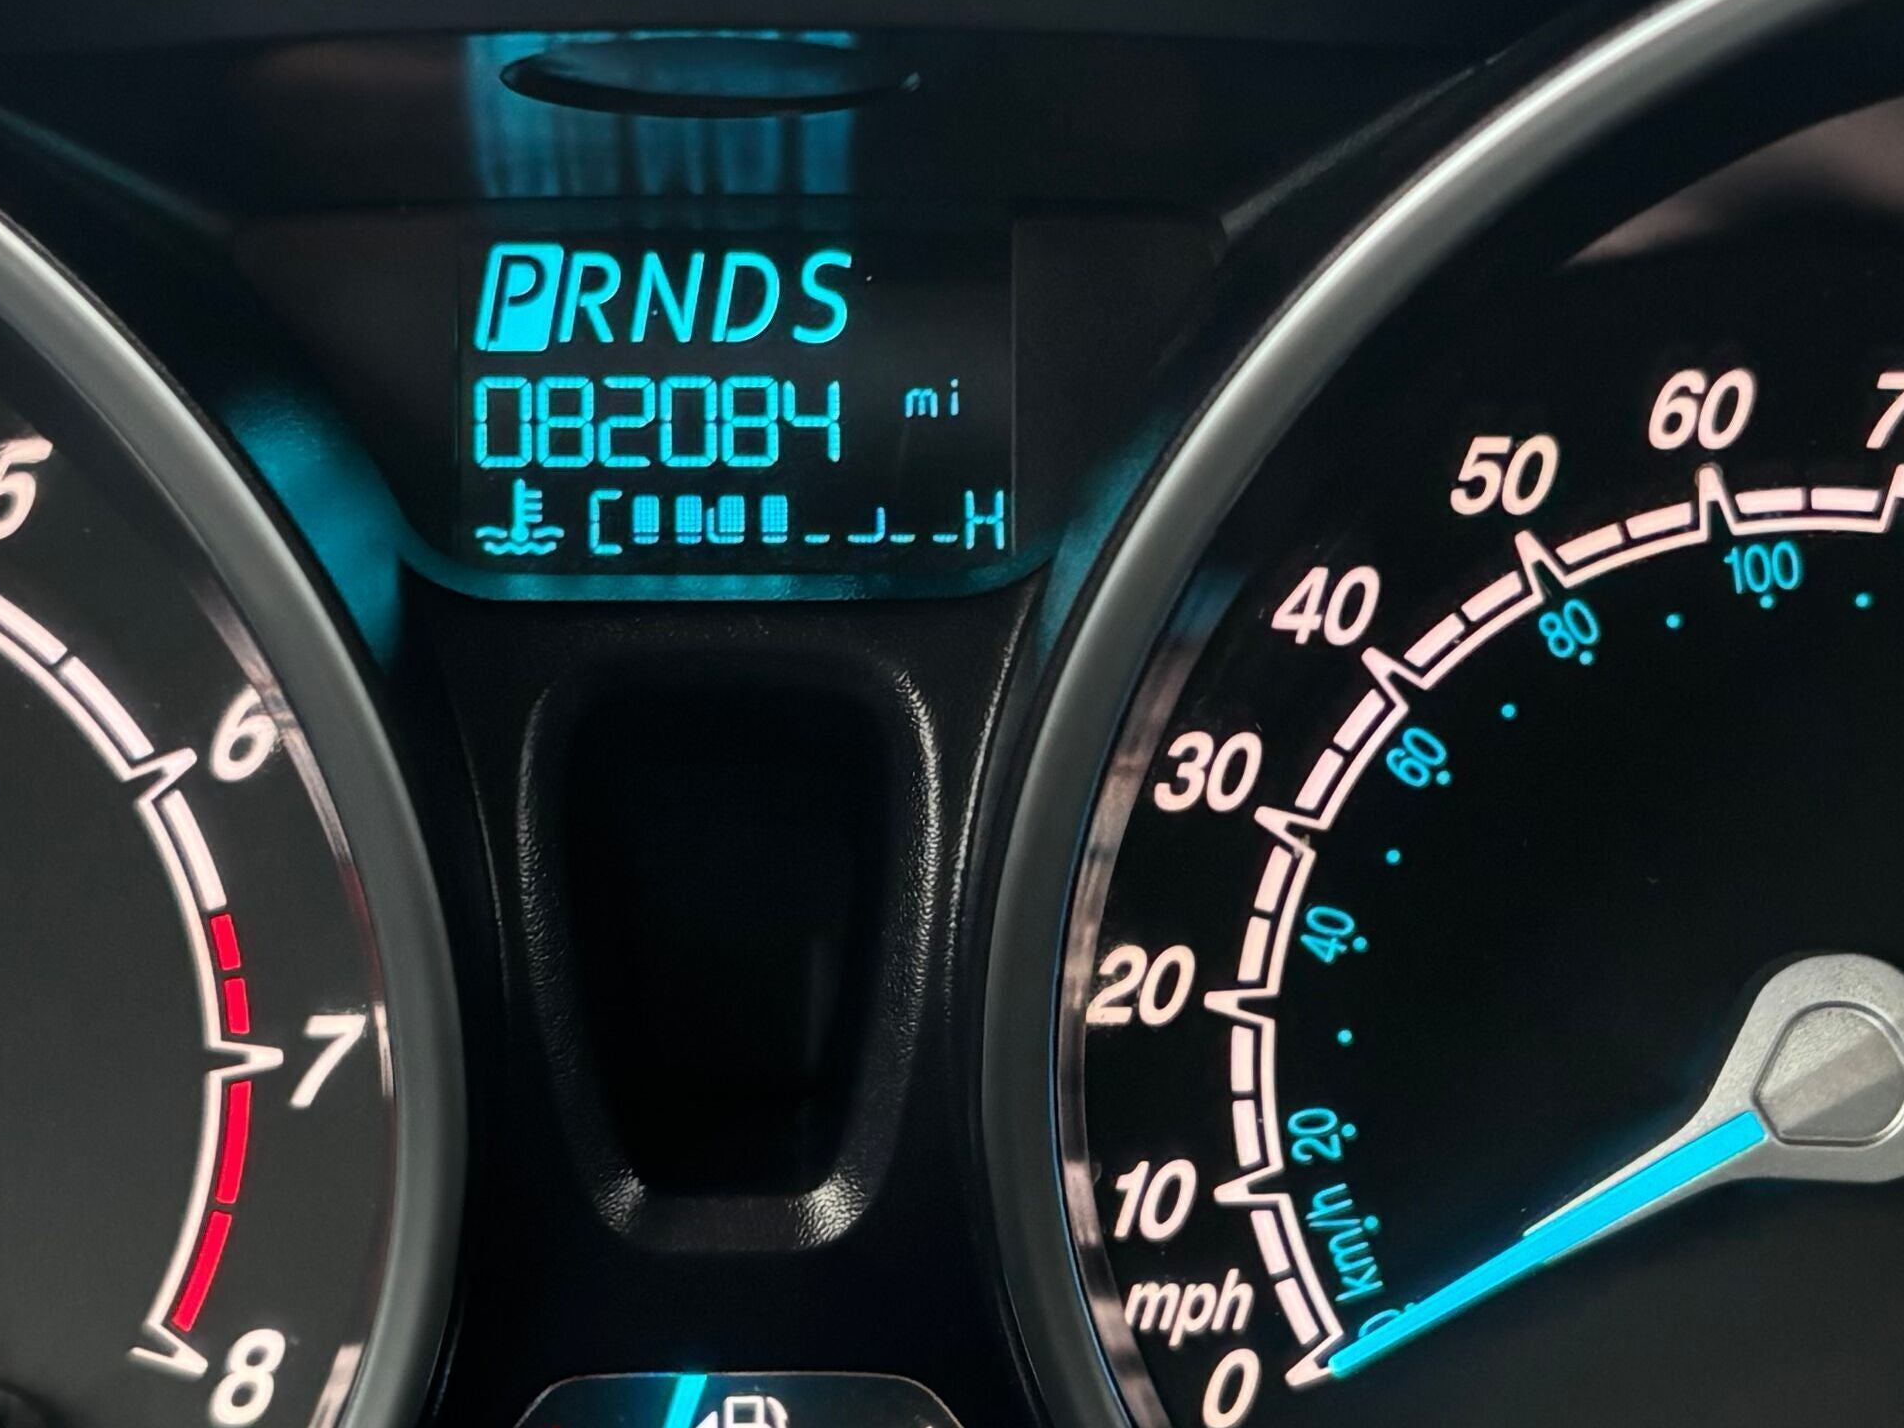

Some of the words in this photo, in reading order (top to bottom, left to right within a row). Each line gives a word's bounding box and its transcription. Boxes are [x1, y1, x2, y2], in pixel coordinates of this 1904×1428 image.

[475, 243, 851, 352] PRNDS
[474, 376, 840, 468] 082084
[905, 378, 959, 418] mi
[1647, 368, 1756, 451] 60
[1450, 434, 1559, 516] 50
[965, 490, 1004, 550] H
[1271, 566, 1381, 646] 40
[1724, 540, 1804, 594] 100
[1537, 599, 1599, 660] 80
[210, 684, 277, 782] 6
[1153, 731, 1263, 813] 30
[1385, 727, 1448, 788] 60
[1300, 905, 1356, 964] 40
[1085, 944, 1196, 1026] 20
[290, 1014, 366, 1109] 7
[1287, 1107, 1344, 1165] 20
[1114, 1159, 1197, 1240] 10
[1307, 1182, 1383, 1301] km/h
[1124, 1268, 1254, 1350] mph
[209, 1328, 286, 1428] 8
